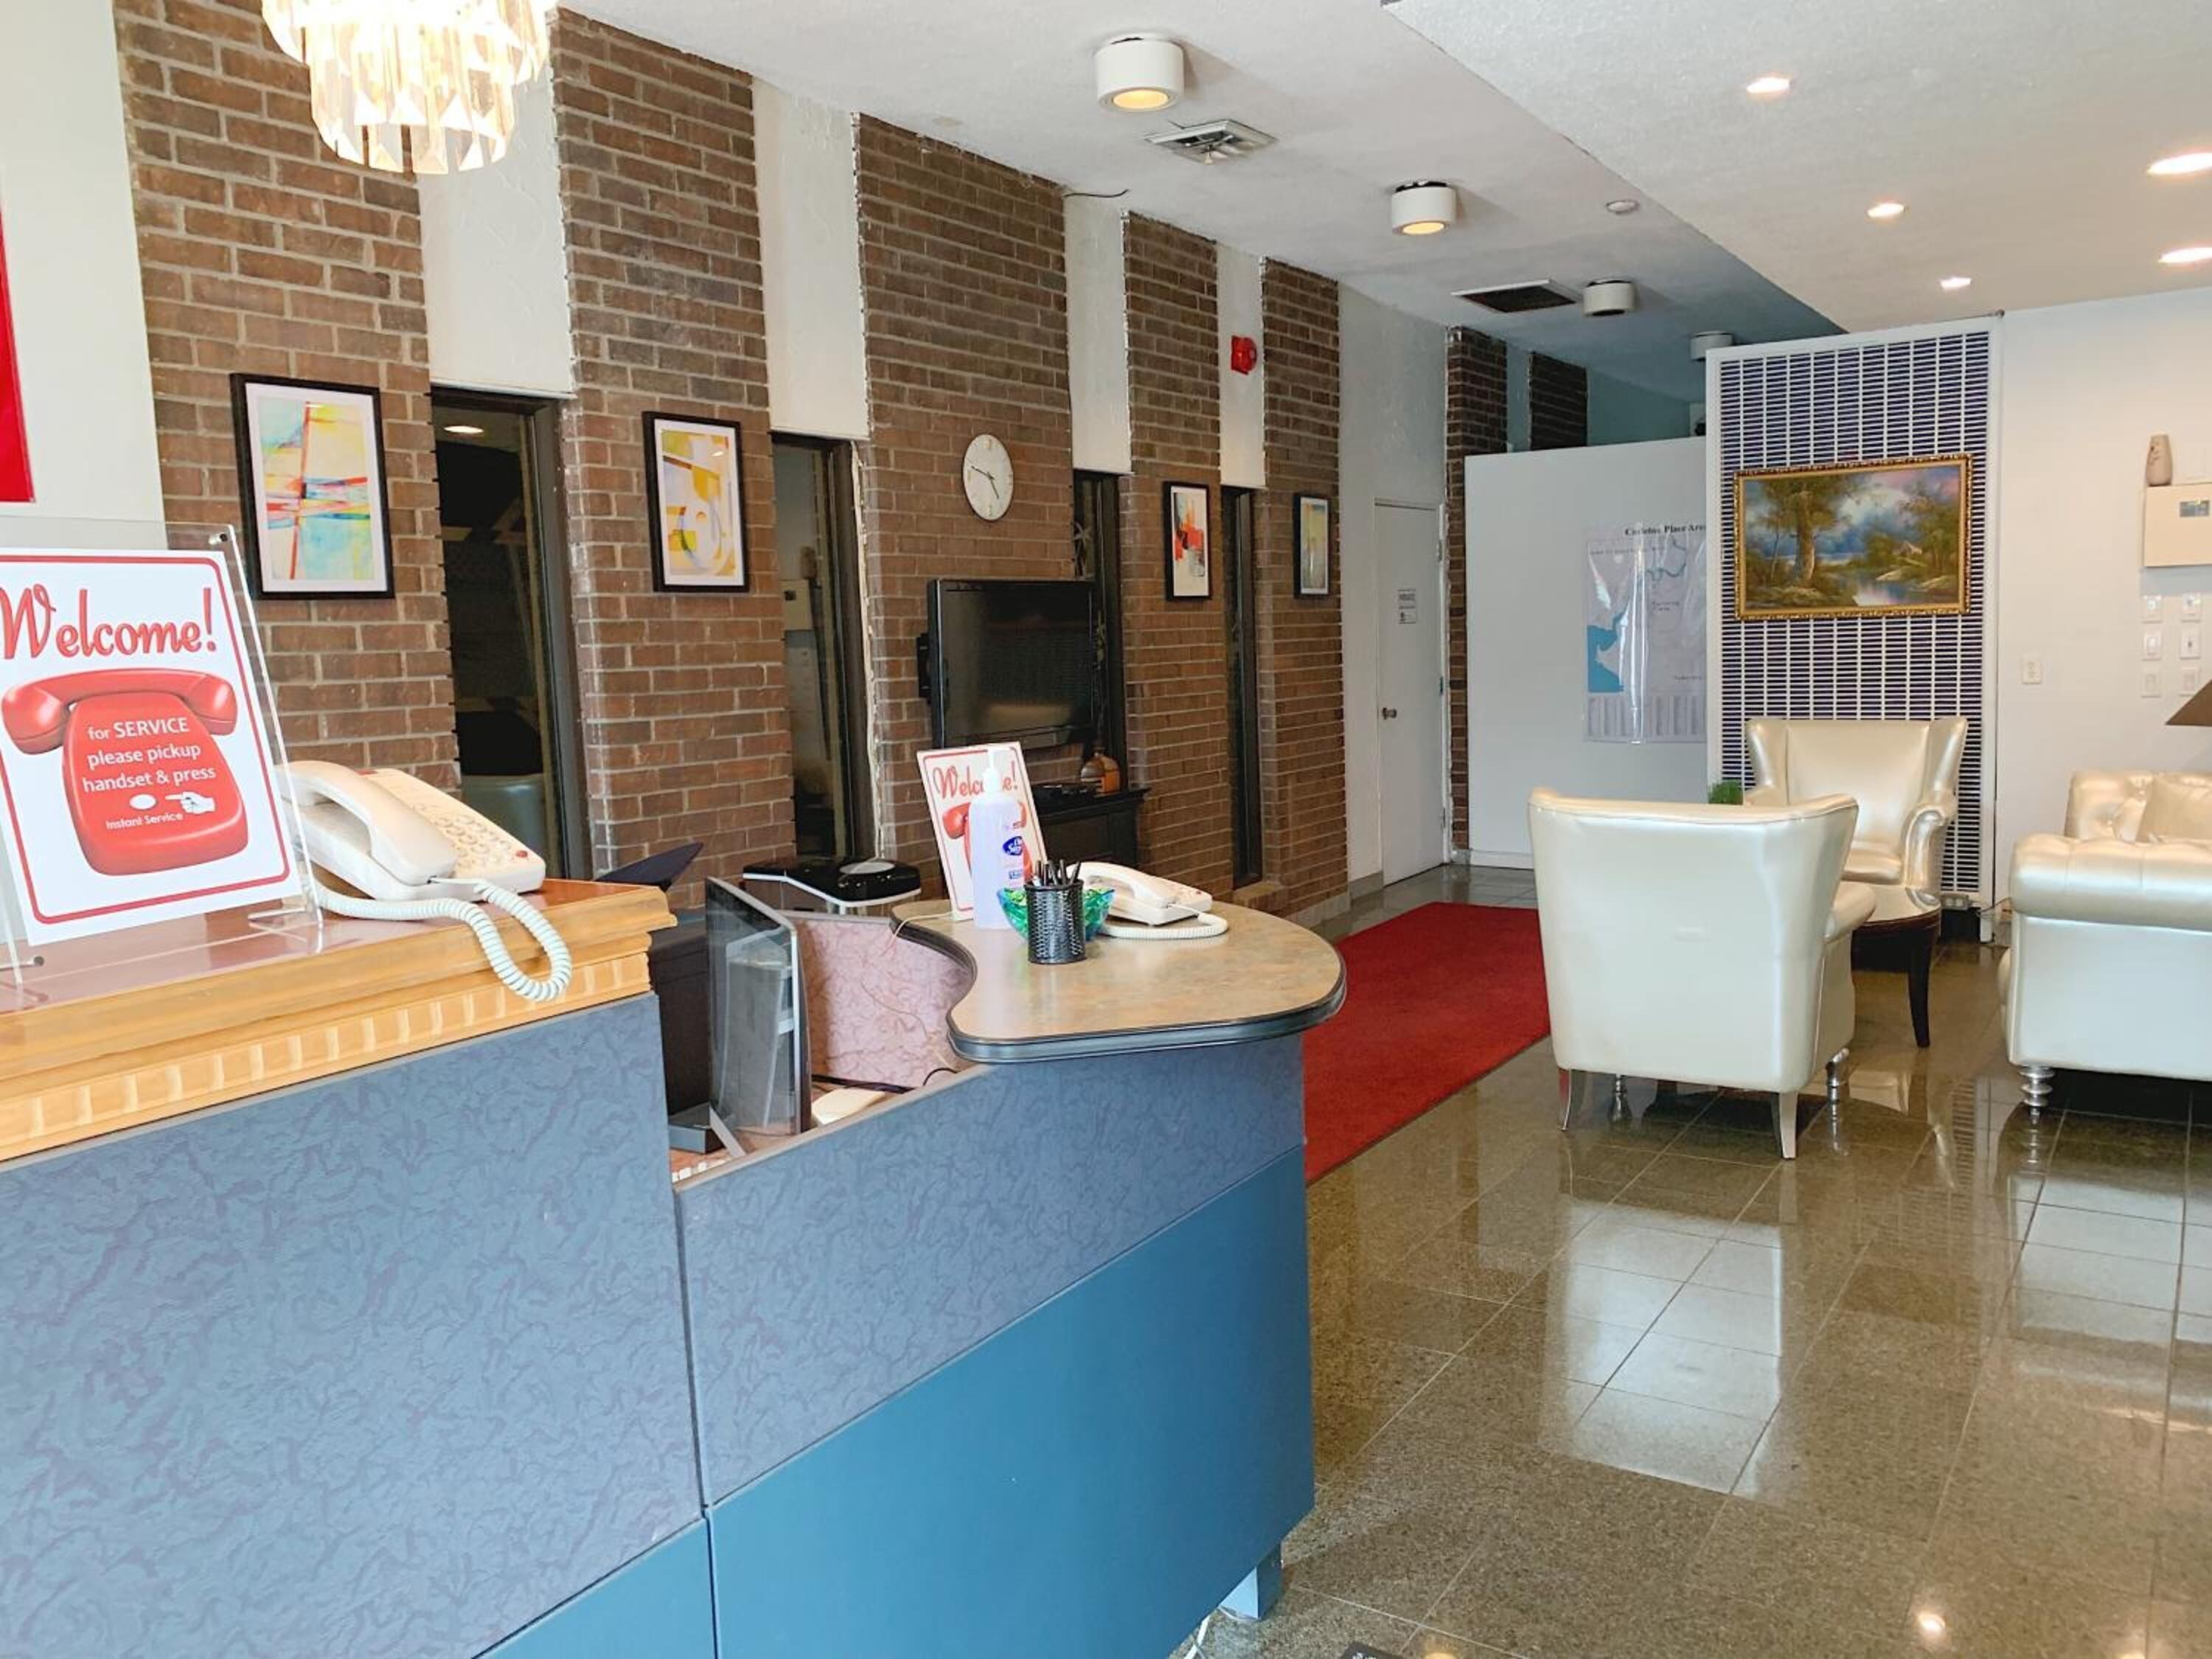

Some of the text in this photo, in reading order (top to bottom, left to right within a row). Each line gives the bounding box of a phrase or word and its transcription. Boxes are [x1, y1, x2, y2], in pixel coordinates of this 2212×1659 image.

[1664, 524, 1687, 533] Place
[0, 583, 217, 660] Welcome!
[88, 717, 189, 740] for SERVICE
[87, 743, 201, 771] please pickup
[82, 767, 217, 793] handset & press
[933, 760, 1018, 800] Welce!
[105, 812, 184, 830] Instant Service
